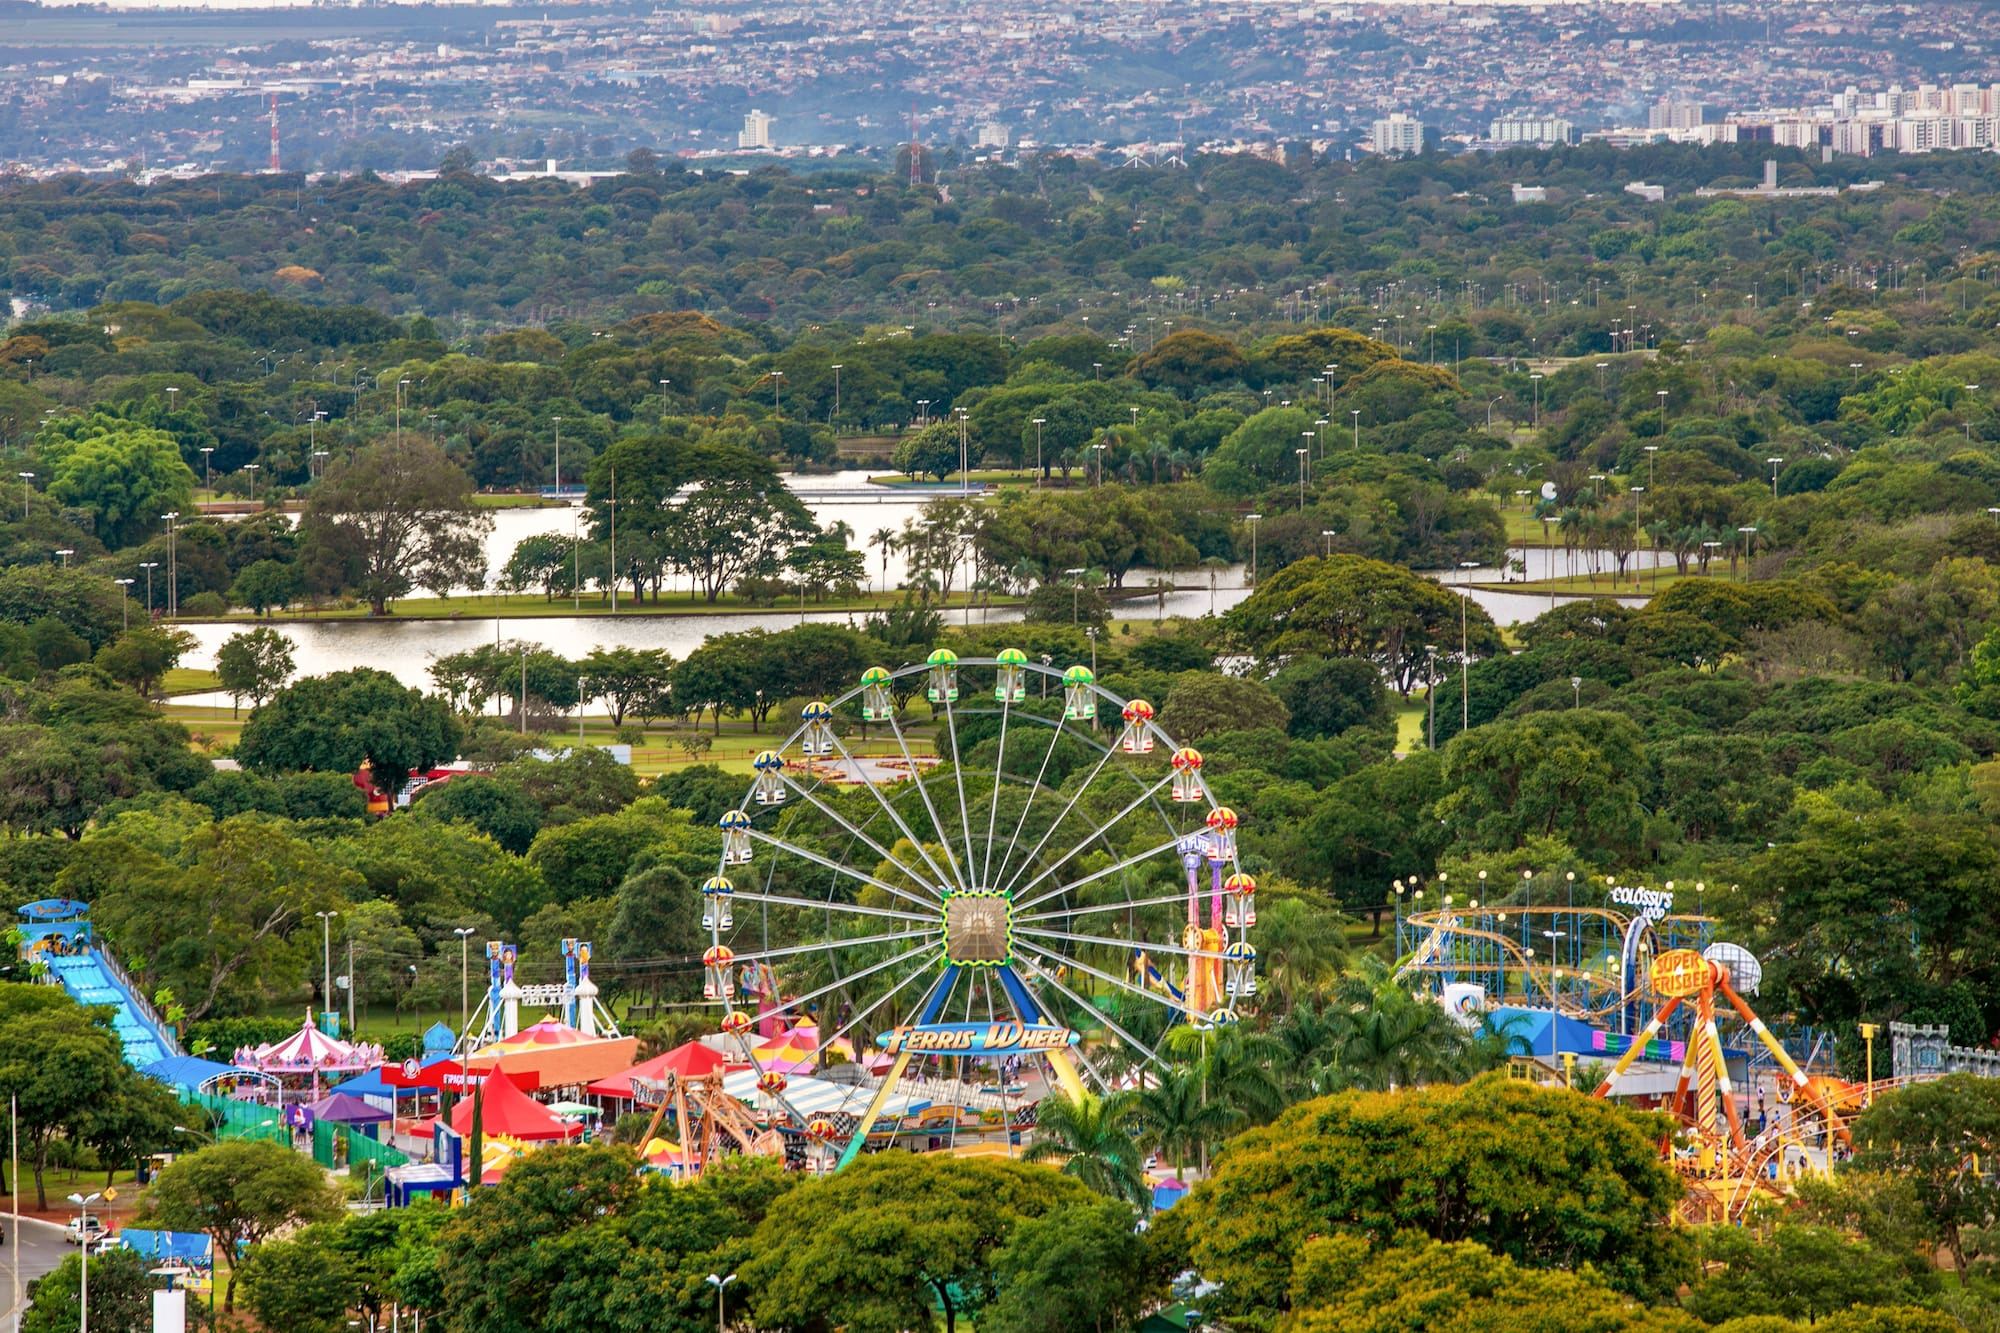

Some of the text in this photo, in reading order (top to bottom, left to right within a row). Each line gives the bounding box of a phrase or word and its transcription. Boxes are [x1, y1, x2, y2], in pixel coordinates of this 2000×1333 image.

[1611, 886, 1673, 908] COLOSSU'S
[1643, 907, 1665, 920] LOOP
[1656, 951, 1700, 974] SUPER
[1653, 970, 1709, 994] FRISBEE
[888, 1020, 1071, 1054] FERRIS WHEEL
